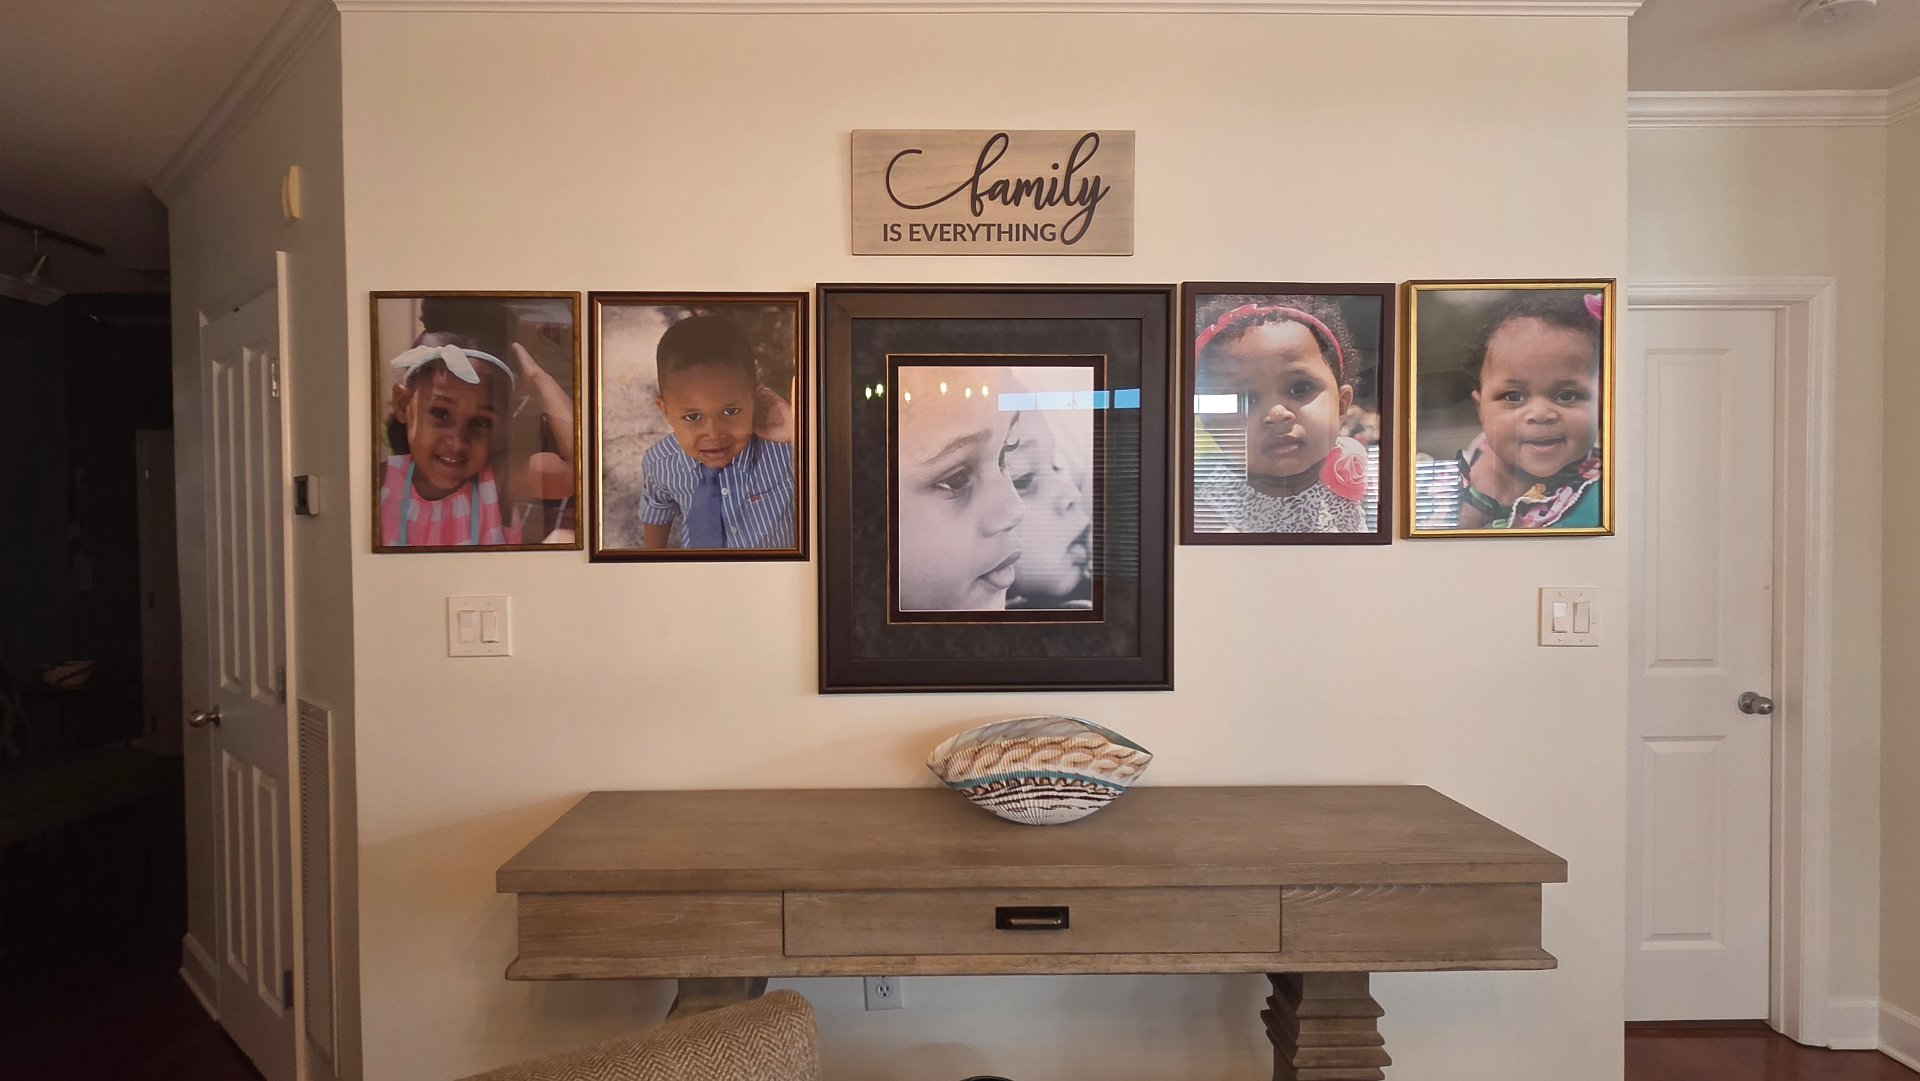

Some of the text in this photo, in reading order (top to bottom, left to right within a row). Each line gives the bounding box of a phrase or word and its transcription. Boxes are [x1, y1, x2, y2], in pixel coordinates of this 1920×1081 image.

[885, 131, 1111, 246] family
[882, 223, 1057, 242] IS EVERYTHING
